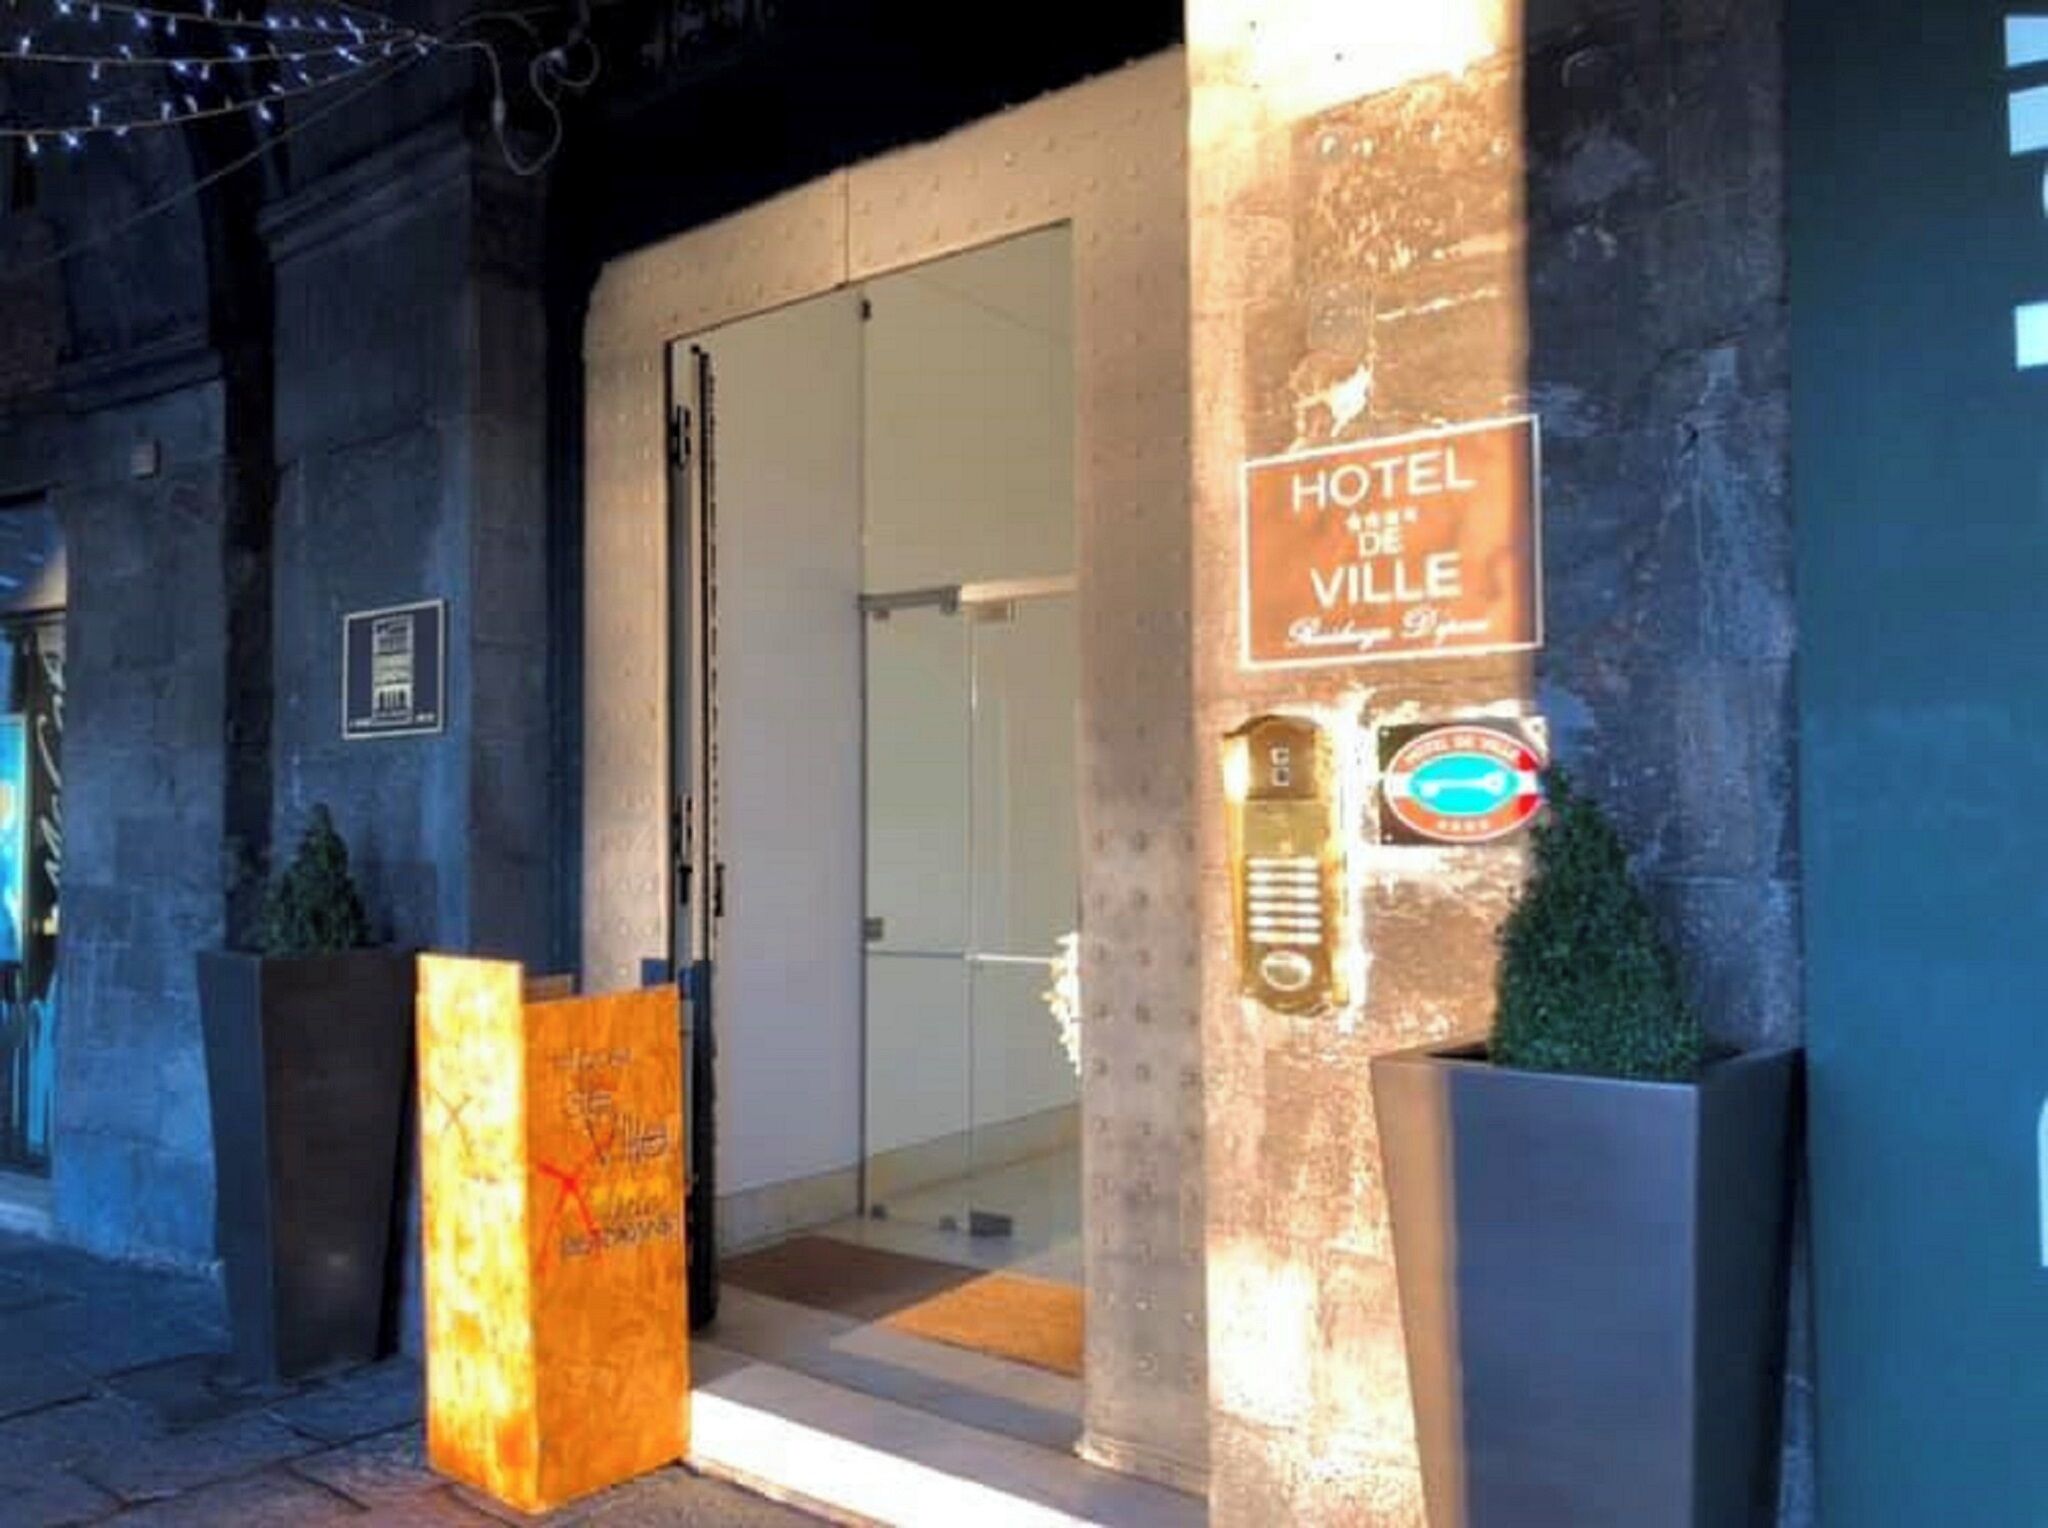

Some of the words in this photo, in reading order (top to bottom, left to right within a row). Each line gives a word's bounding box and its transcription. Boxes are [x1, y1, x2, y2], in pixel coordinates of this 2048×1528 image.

[1292, 447, 1476, 512] HOTEL
[1359, 529, 1402, 557] DE
[1310, 552, 1462, 609] VILLE
